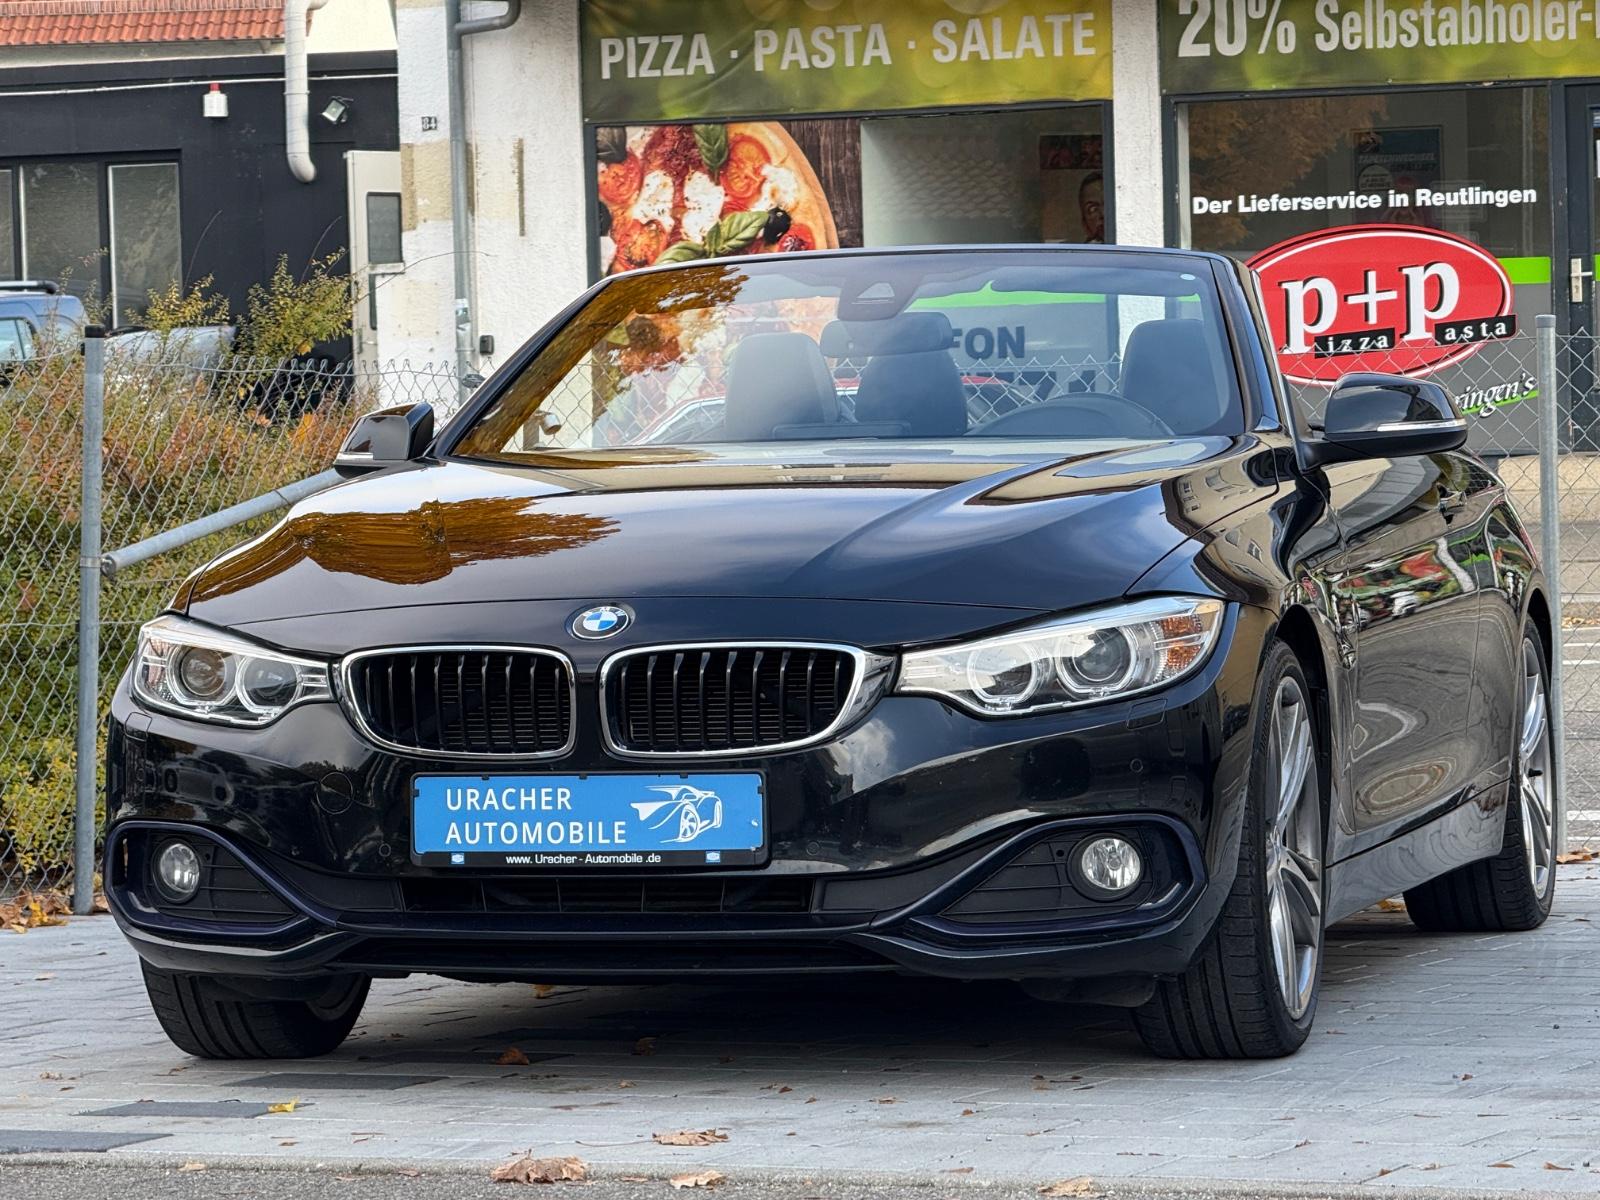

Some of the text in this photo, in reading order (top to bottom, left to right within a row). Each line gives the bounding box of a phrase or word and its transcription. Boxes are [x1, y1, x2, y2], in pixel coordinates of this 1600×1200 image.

[1178, 0, 1600, 57] 20% Selbstabholer-
[601, 12, 1096, 80] PIZZA PASTA SALATE
[1192, 187, 1537, 214] Der Lieferservice in Reutlingen
[447, 788, 572, 811] URACHER
[445, 820, 627, 845] AUTOMOBILE
